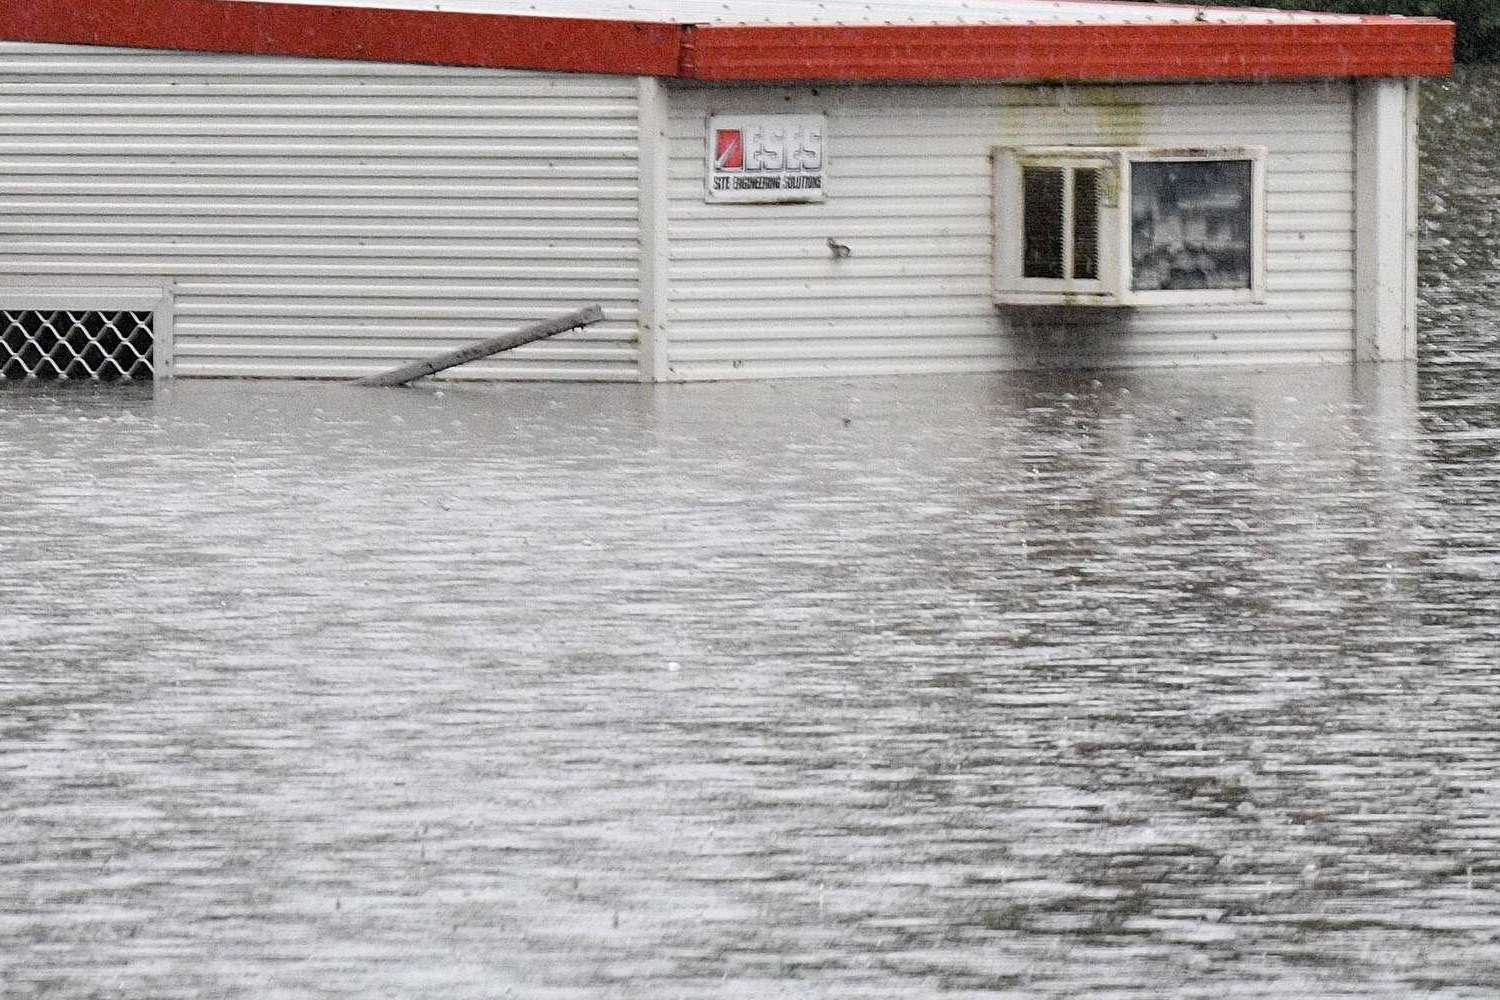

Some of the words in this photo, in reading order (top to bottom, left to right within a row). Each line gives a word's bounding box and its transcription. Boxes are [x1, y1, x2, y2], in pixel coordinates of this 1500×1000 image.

[713, 175, 730, 190] SITE
[733, 175, 781, 190] ENGINEERING
[783, 175, 822, 189] SOLUTIONS
